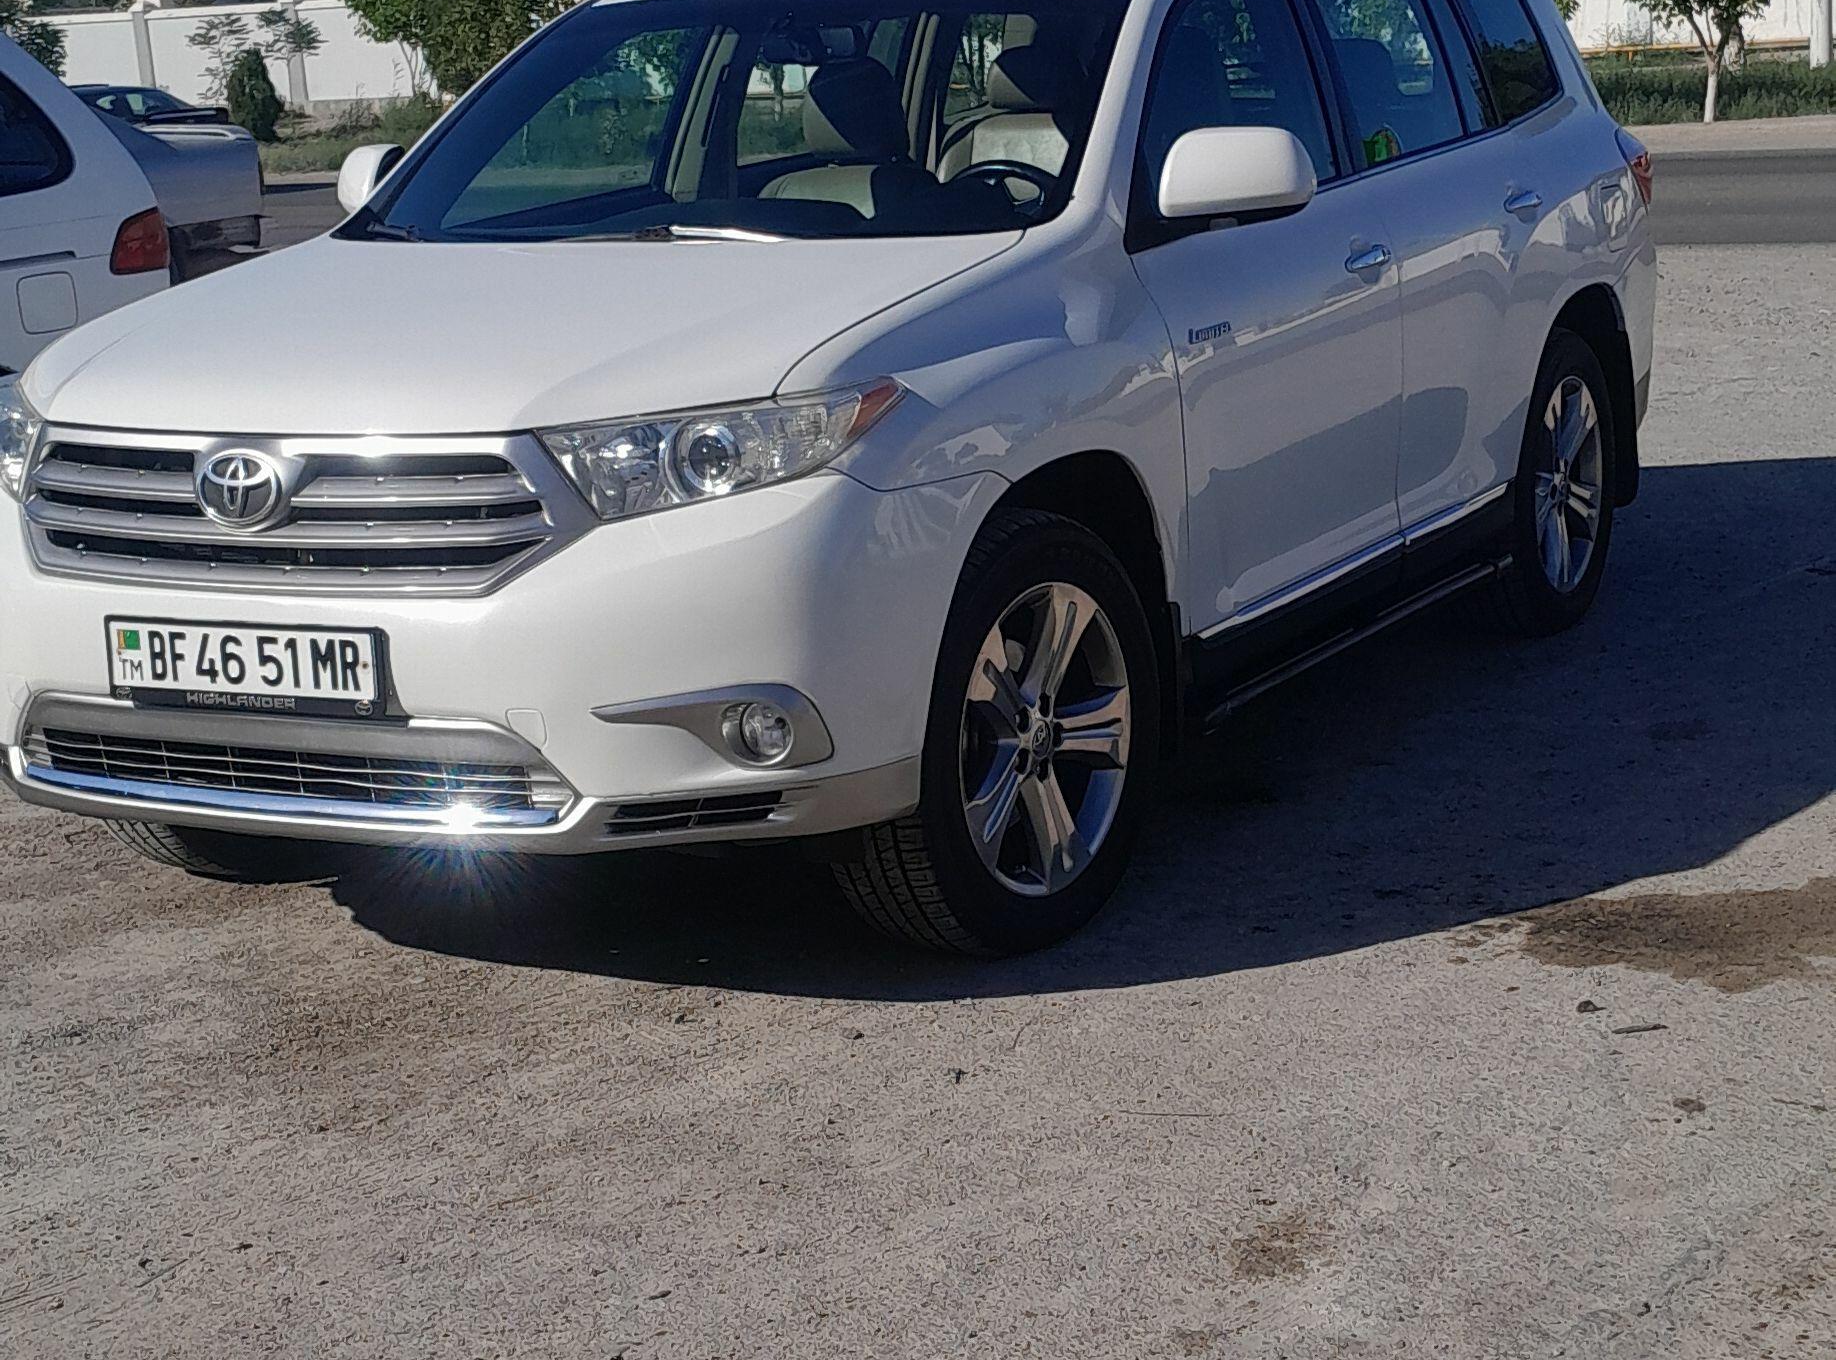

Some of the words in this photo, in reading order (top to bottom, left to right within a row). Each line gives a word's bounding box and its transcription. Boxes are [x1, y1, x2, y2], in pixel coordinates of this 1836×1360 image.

[119, 658, 144, 682] TM
[147, 630, 187, 682] BF
[196, 633, 246, 685] 46
[256, 636, 301, 689] 51
[309, 638, 361, 691] MR
[186, 691, 296, 710] HIGHLANDER
